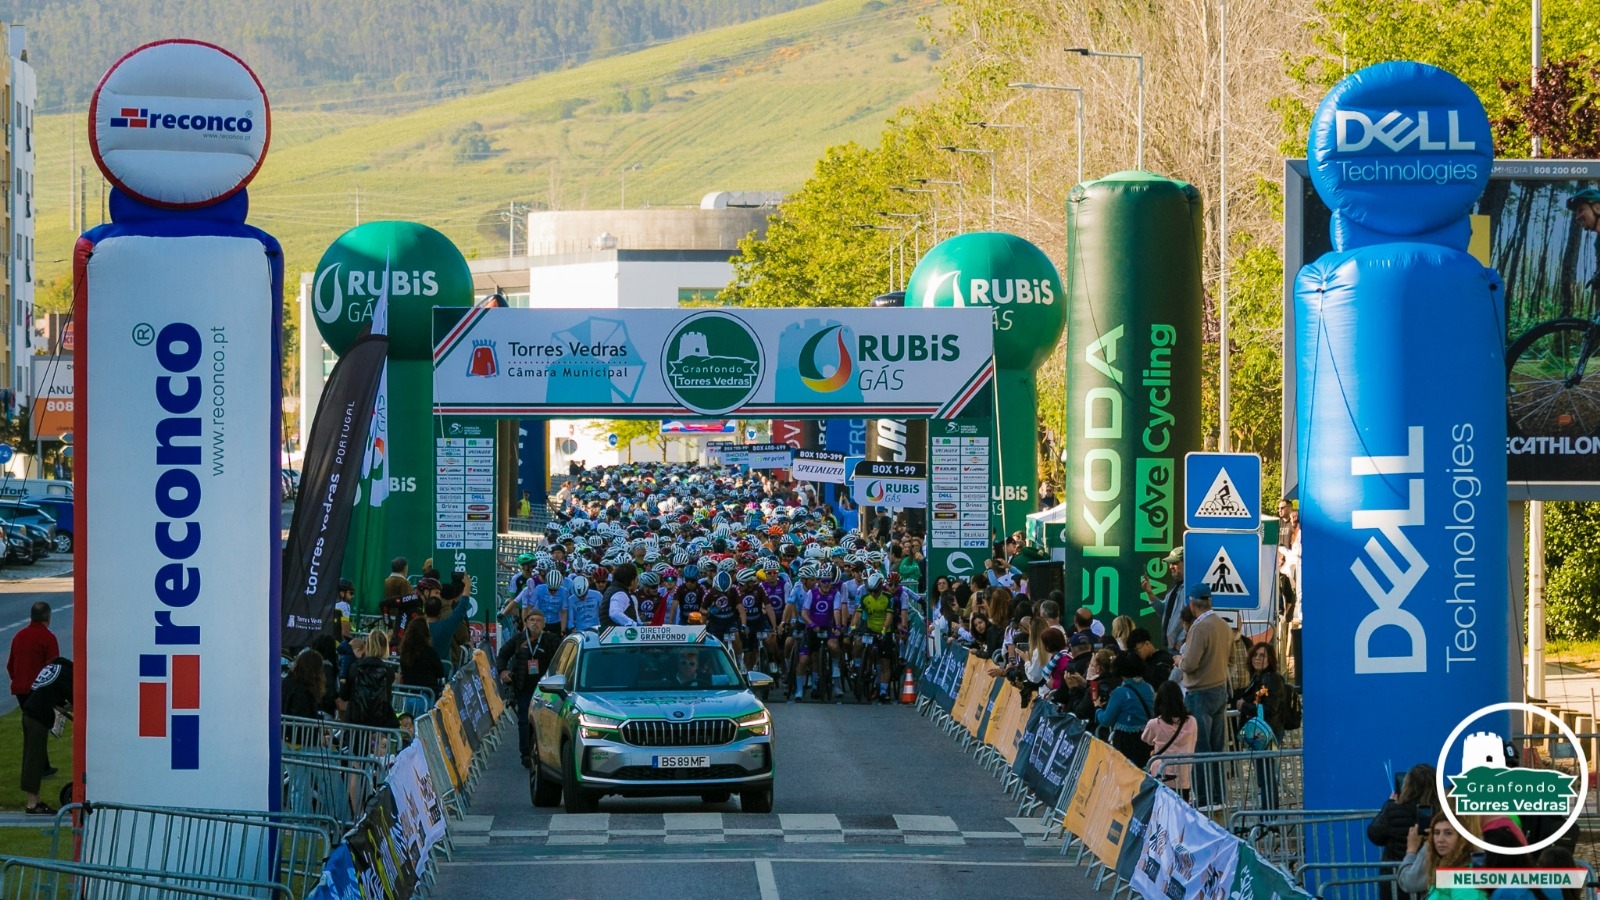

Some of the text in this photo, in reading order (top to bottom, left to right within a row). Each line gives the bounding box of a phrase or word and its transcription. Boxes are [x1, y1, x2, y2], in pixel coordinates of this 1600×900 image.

[150, 113, 252, 133] reconco
[203, 132, 250, 142] www.reconco.pt
[1336, 110, 1476, 152] DELL
[1336, 160, 1478, 184] Technologies
[1534, 166, 1550, 174] 808
[1552, 166, 1569, 174] 200
[1570, 166, 1588, 174] 600
[348, 298, 374, 322] GÁ
[508, 342, 628, 357] Torres Vedras
[508, 366, 628, 380] Câmara Municipal
[682, 366, 742, 374] Granfondo
[858, 365, 904, 390] GÁS
[678, 376, 750, 386] Torres Vedras
[1142, 324, 1176, 452] Cycling
[48, 386, 74, 394] ANU
[46, 402, 74, 412] 808
[211, 326, 228, 477] www.reconco.pt
[1506, 436, 1600, 455] CATHLON
[800, 450, 843, 460] BOX 100-399
[797, 464, 844, 476] SPECIALIZED
[872, 465, 916, 475] BOX 1-99
[155, 322, 202, 645] reconco
[390, 477, 416, 492] BiS
[305, 536, 324, 596] torres
[336, 400, 354, 464] PORTUGAL
[885, 494, 901, 502] GÁS
[992, 486, 1028, 501] UBiS
[1350, 426, 1430, 674] DELL
[1445, 422, 1481, 673] Technologies
[662, 756, 706, 767] BS 89 MF
